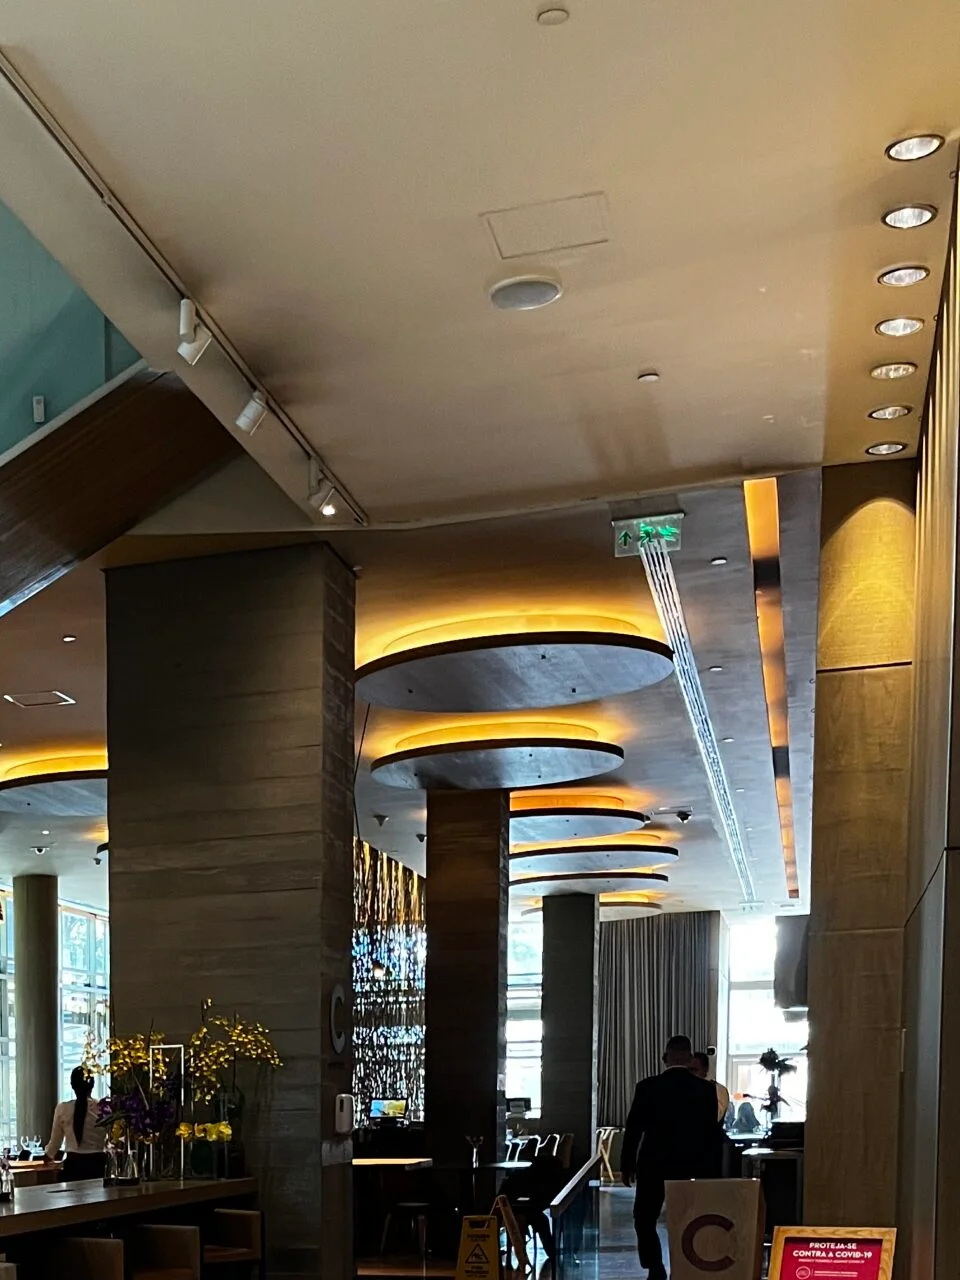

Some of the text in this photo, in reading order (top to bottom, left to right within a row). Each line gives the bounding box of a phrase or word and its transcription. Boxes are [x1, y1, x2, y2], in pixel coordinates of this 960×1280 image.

[330, 982, 345, 1054] C
[682, 1214, 735, 1272] C
[792, 1250, 827, 1258] CONTRA
[835, 1251, 873, 1259] COVID-19
[809, 1242, 857, 1250] PROTEJA-SE
